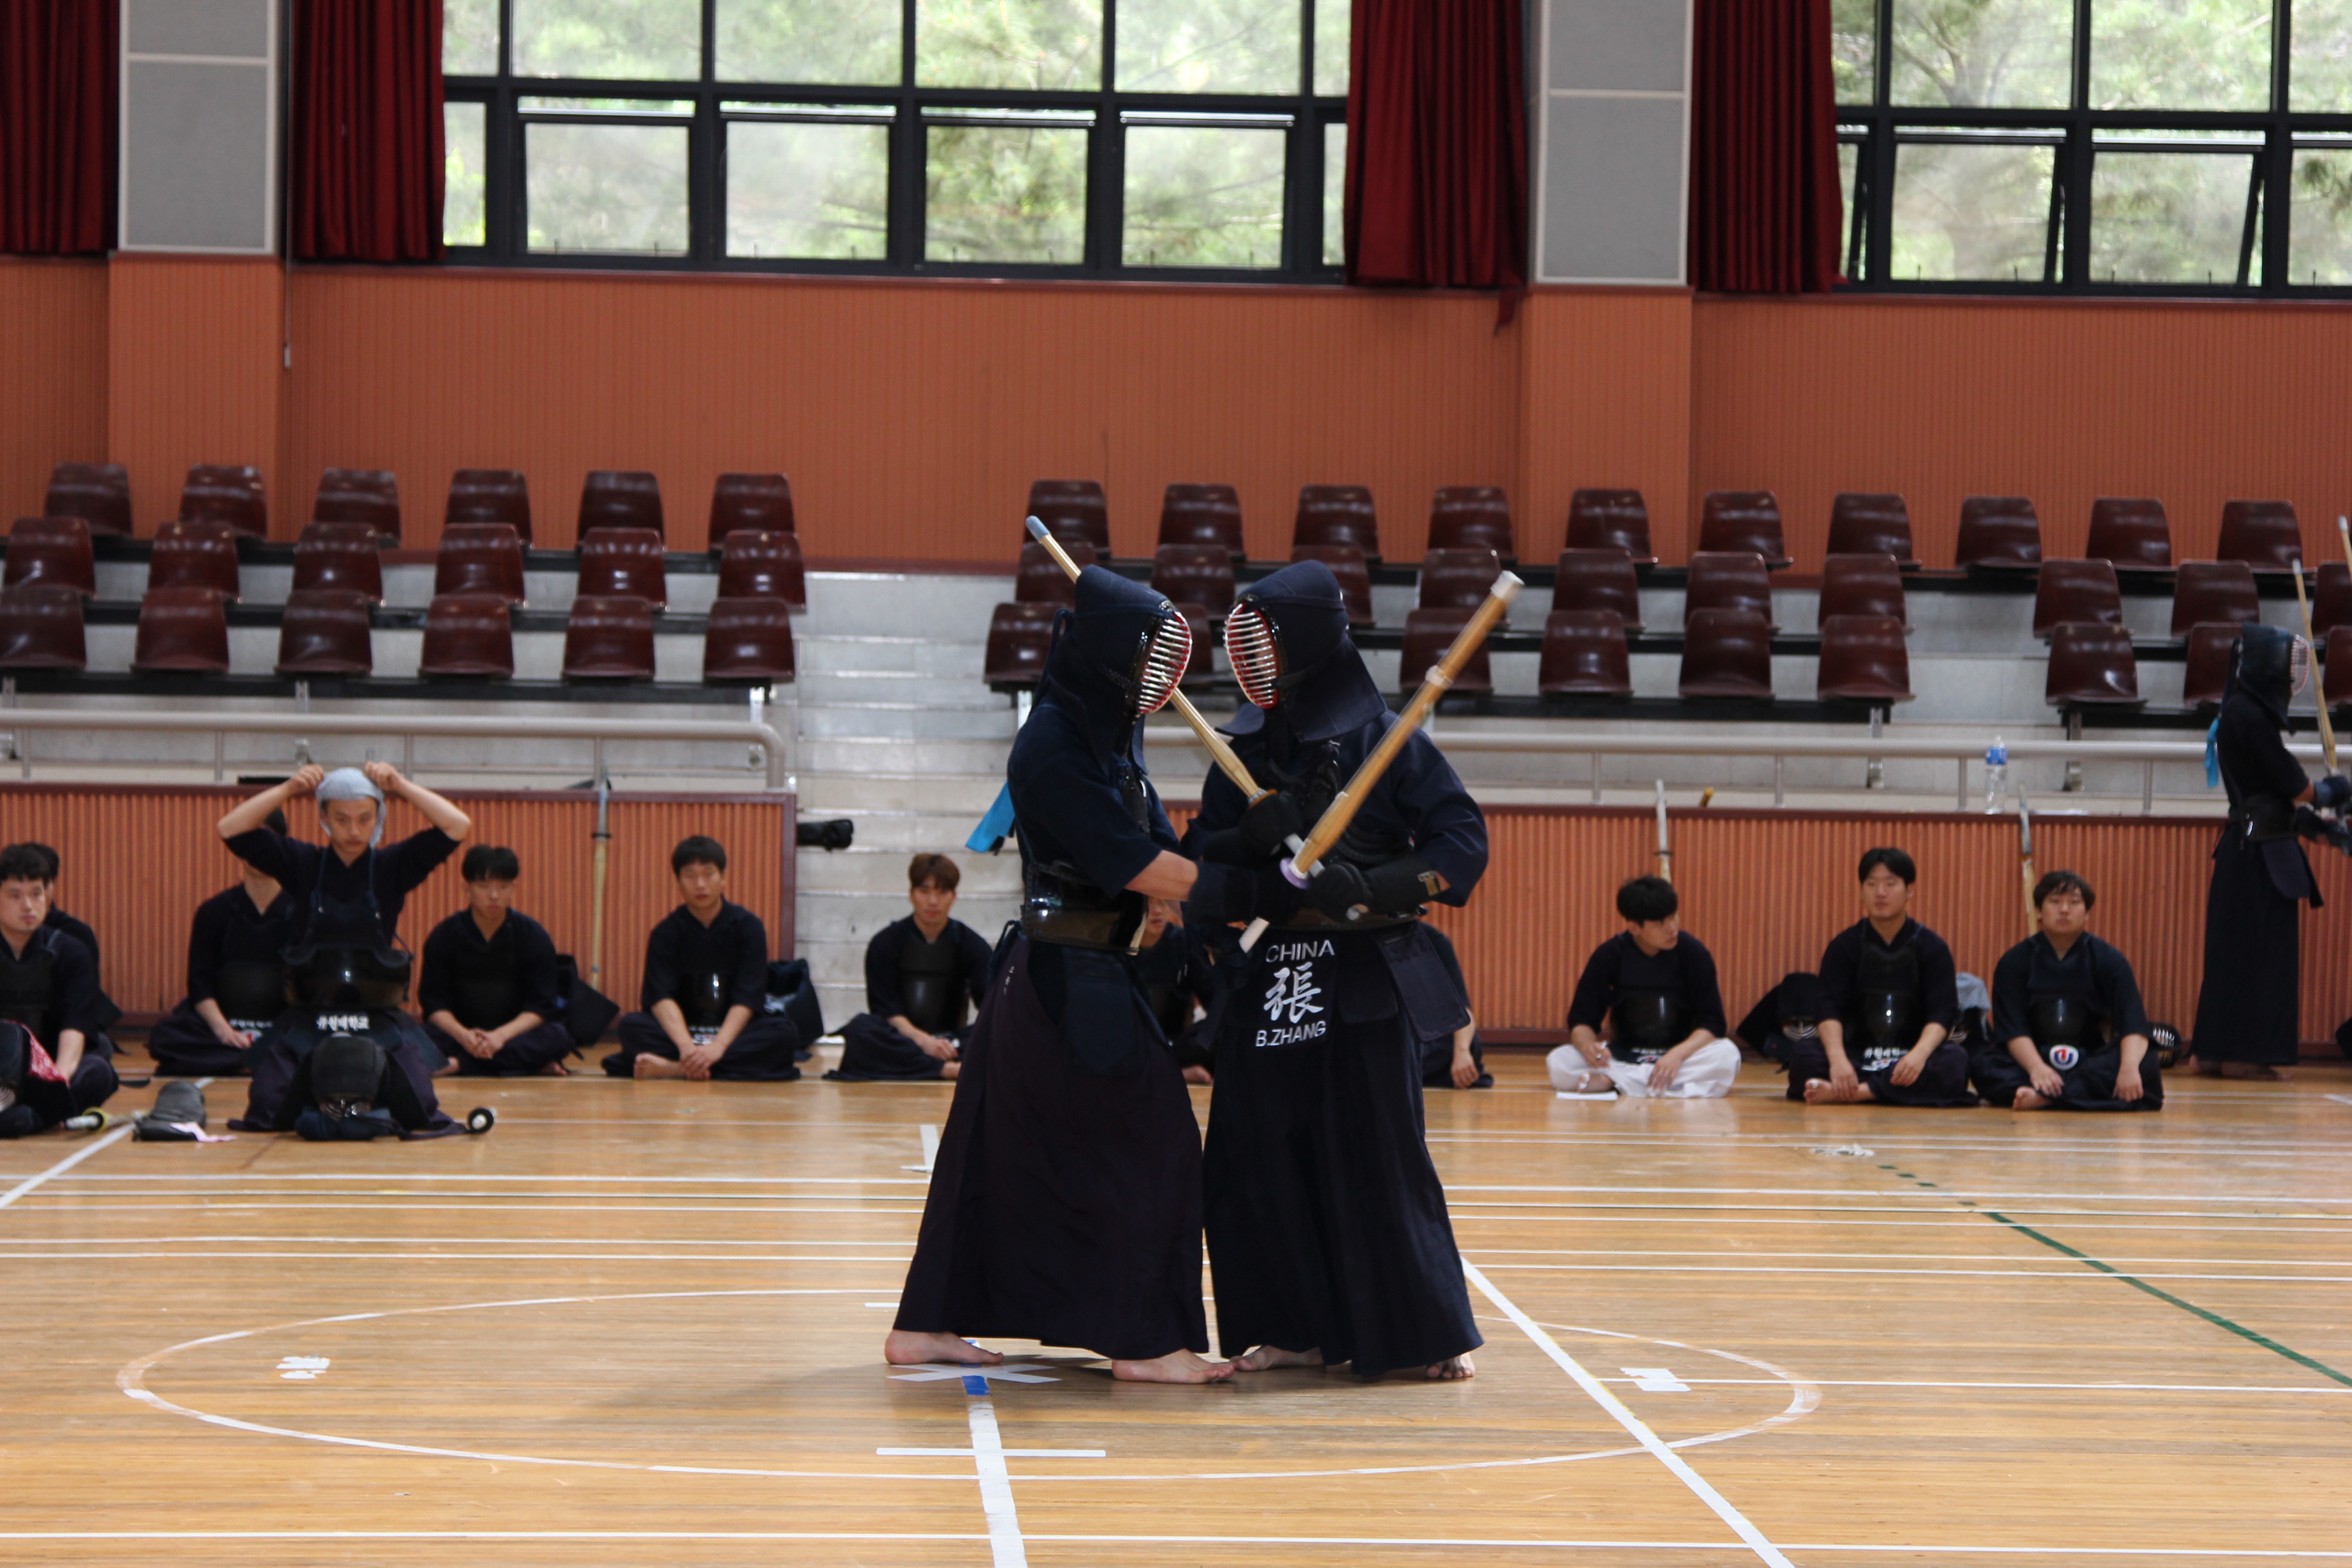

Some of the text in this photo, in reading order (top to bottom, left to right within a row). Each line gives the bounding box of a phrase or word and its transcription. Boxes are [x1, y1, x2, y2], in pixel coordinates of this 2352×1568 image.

[1265, 939, 1335, 963] CHINA
[1263, 962, 1324, 1024] 張
[1255, 1020, 1326, 1047] B.ZHANG
